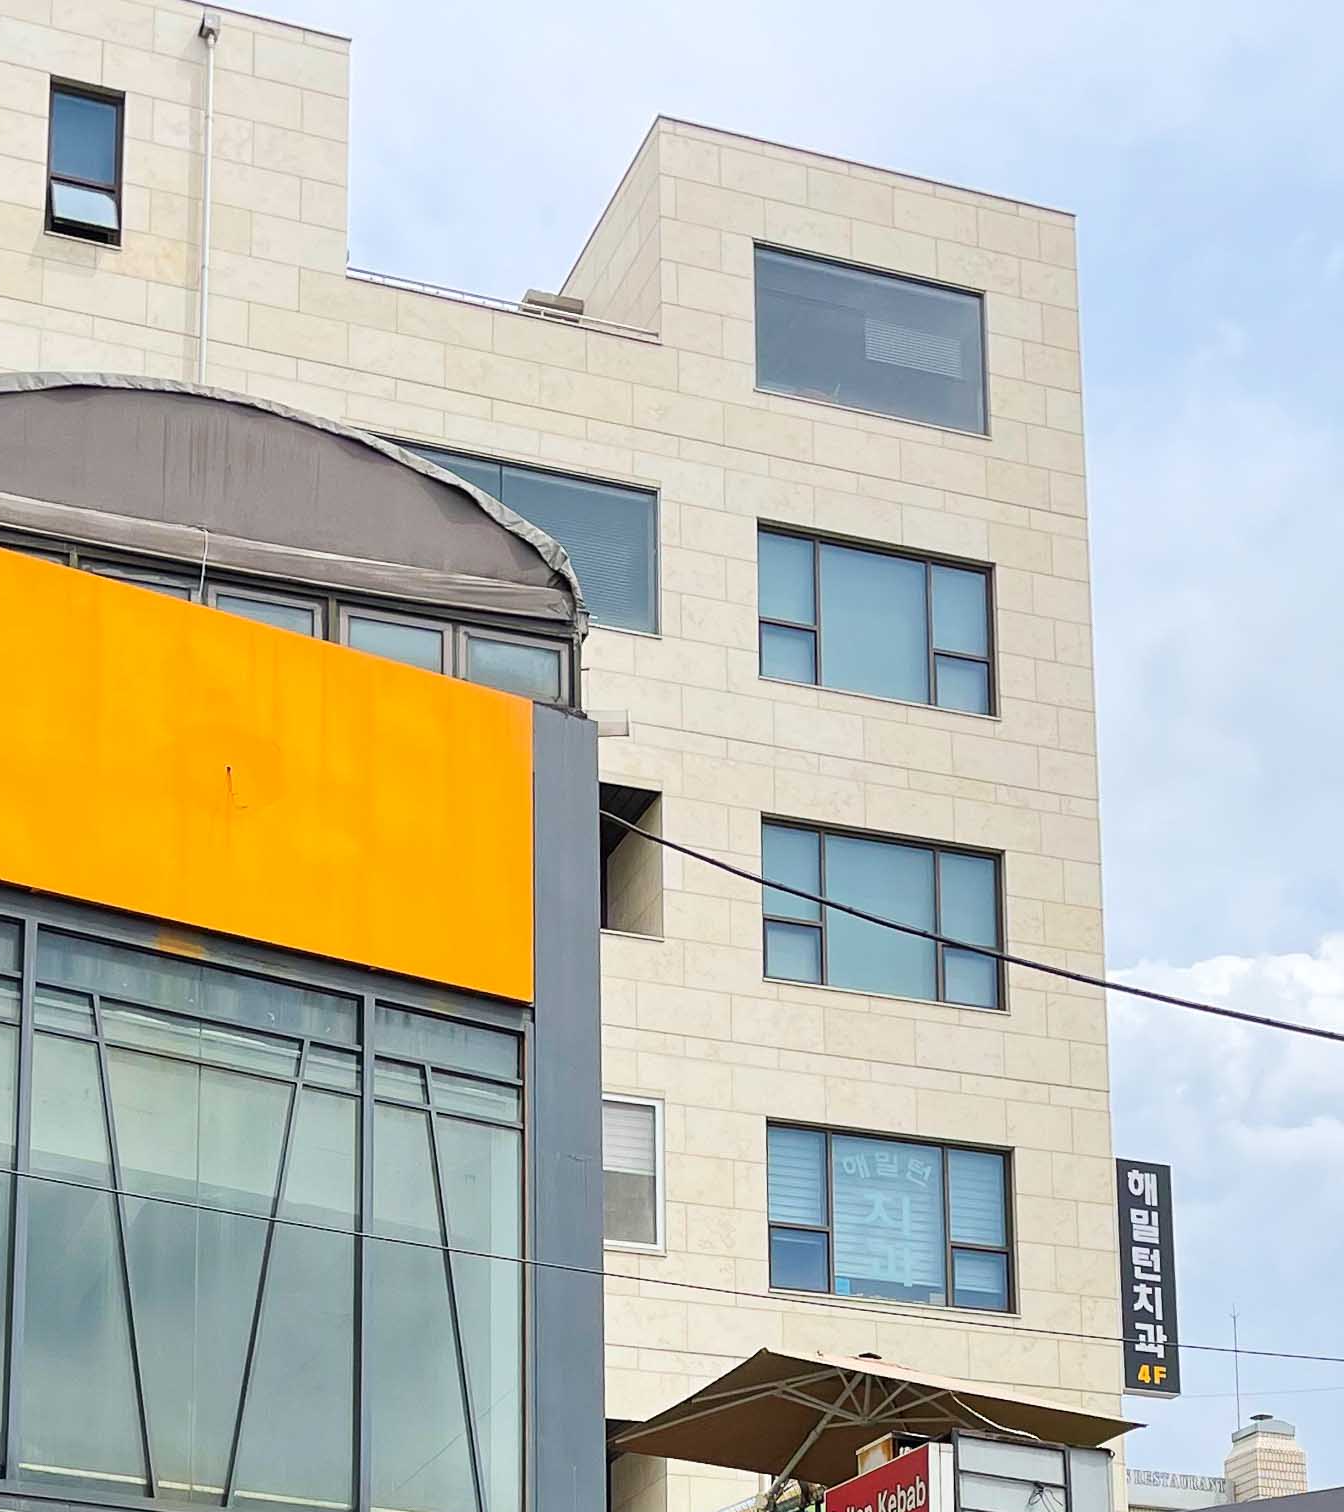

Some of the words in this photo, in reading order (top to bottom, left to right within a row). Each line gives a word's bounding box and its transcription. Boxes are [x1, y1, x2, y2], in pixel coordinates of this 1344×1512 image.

[1127, 1169, 1168, 1360] 해밀턴치과
[1137, 1363, 1168, 1386] 4F
[1135, 1469, 1226, 1494] RESTAURANT
